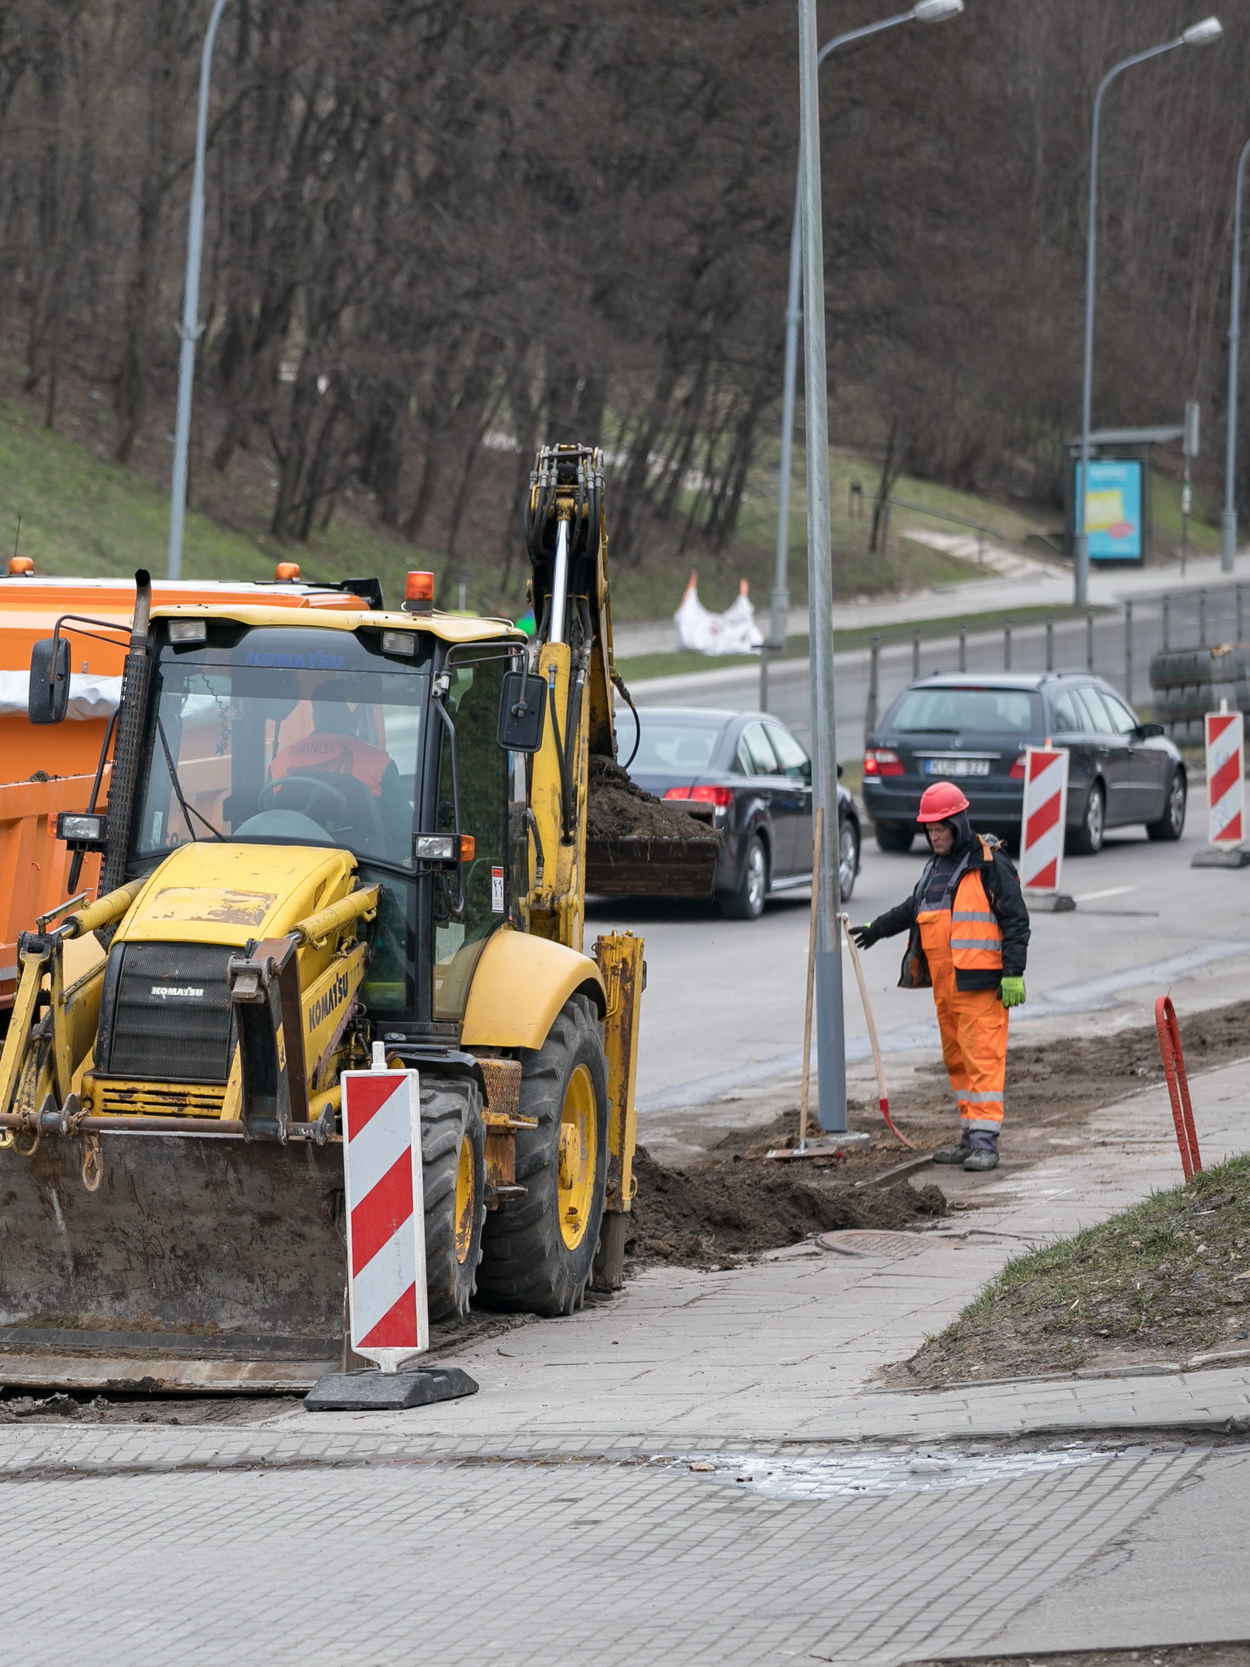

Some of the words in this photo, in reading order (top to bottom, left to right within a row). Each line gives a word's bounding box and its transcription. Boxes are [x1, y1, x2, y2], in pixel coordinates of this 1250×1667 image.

[246, 650, 344, 668] KOMATSU
[151, 986, 204, 999] KOMATSU
[308, 971, 349, 1033] KOMATSU
